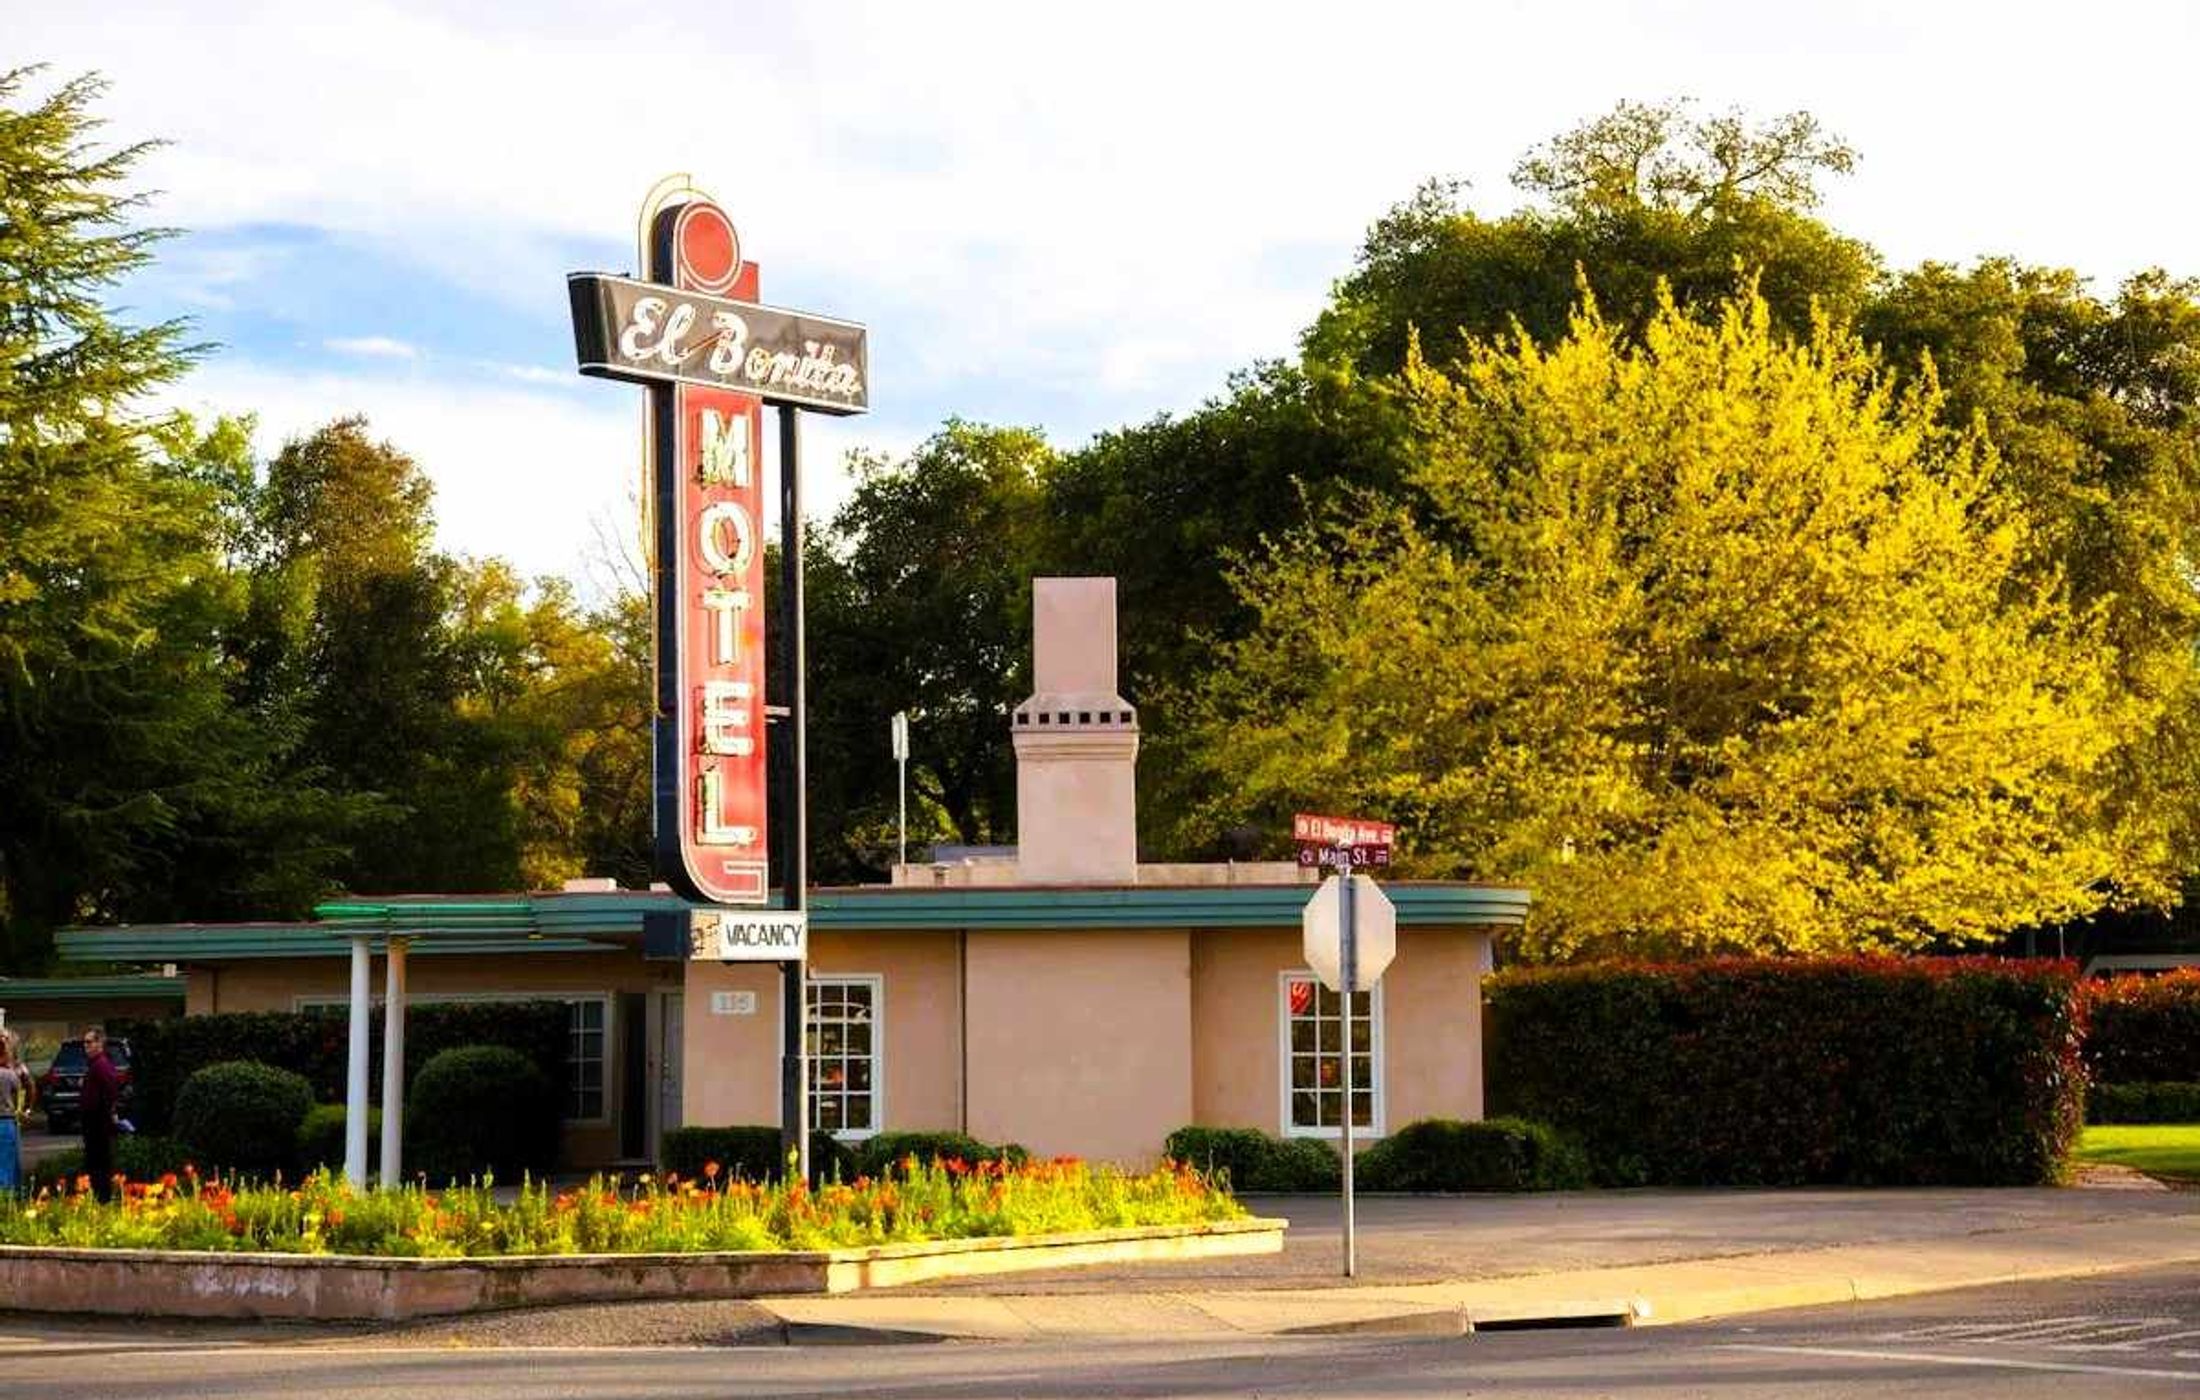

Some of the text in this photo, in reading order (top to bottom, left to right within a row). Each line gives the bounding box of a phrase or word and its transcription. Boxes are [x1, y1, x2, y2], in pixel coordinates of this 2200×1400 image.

[620, 297, 862, 396] El Bonita
[693, 406, 758, 848] MOTEL
[1318, 847, 1350, 864] Main
[726, 923, 802, 946] VACANCY
